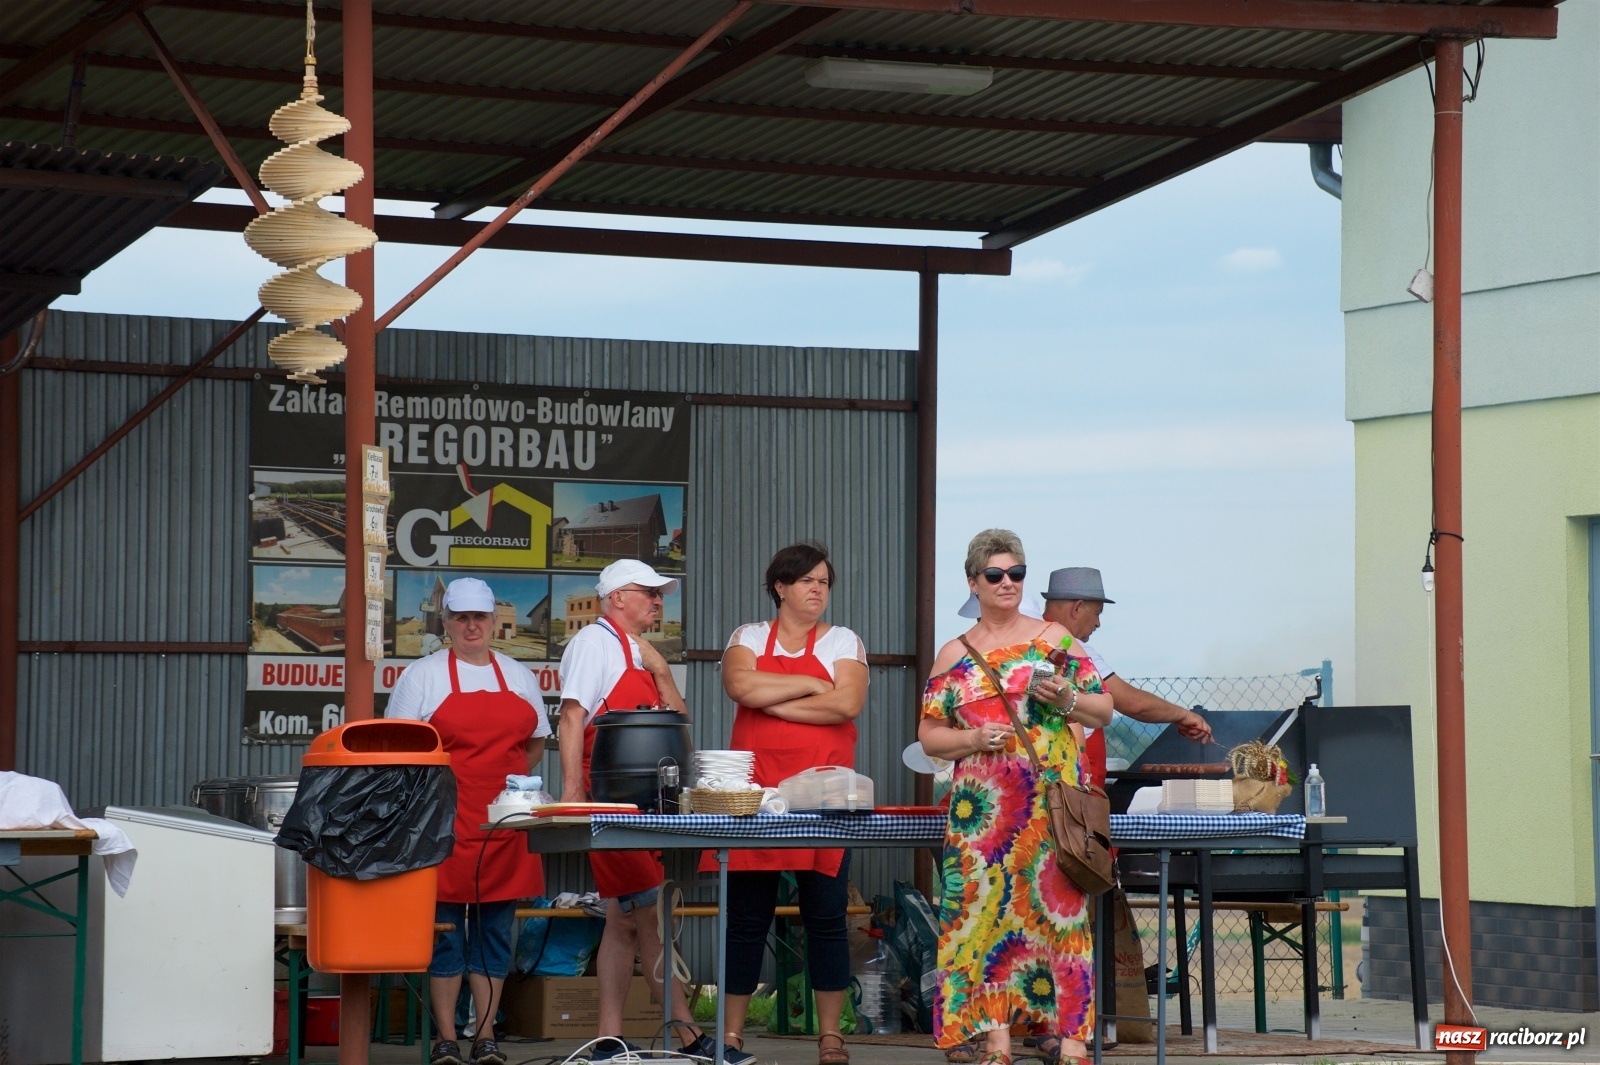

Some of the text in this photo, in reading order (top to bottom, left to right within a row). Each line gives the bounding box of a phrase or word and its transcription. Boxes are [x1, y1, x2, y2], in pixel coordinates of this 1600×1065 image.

[268, 383, 675, 432] Zakła Remontowo-Budowlany
[332, 422, 613, 471] „REGORBAU”
[262, 663, 376, 687] BUDUJE
[259, 710, 314, 735] Kom.
